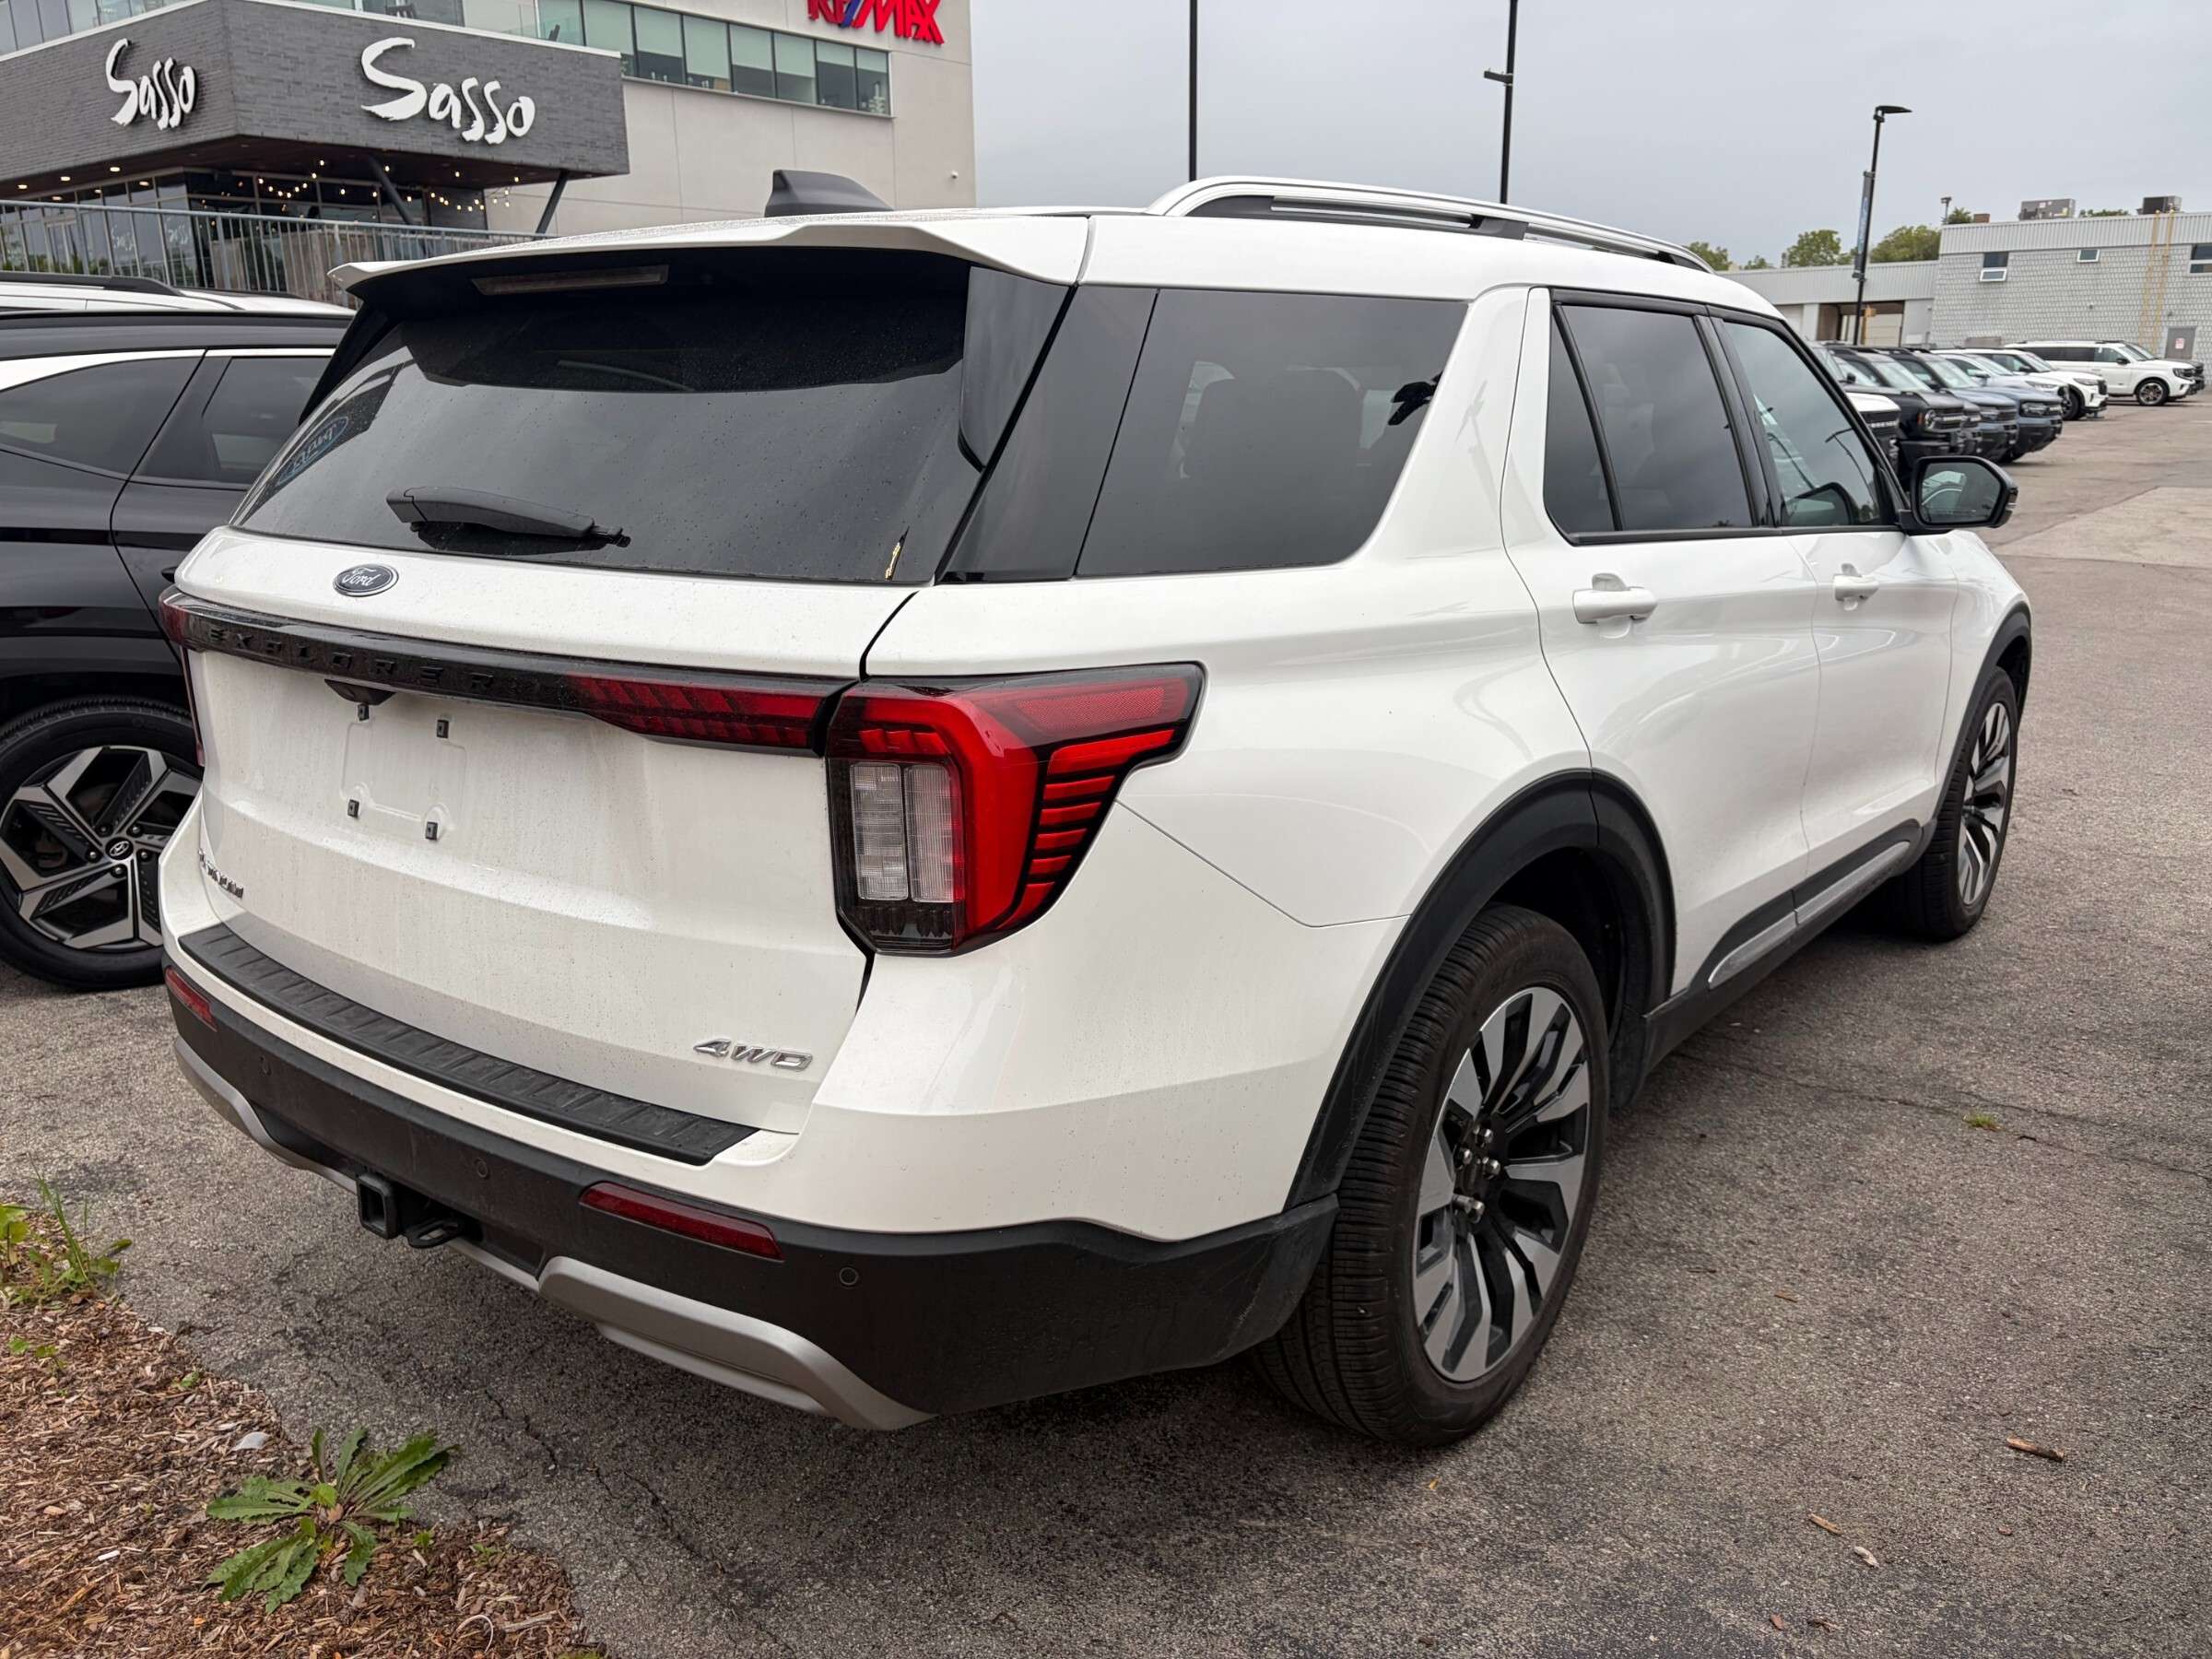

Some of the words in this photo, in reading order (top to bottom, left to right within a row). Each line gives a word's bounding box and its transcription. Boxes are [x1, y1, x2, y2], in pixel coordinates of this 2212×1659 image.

[105, 38, 196, 131] Sasso
[359, 36, 535, 145] Sasso
[207, 627, 495, 689] EXPLORER
[693, 1038, 813, 1072] 4WD
